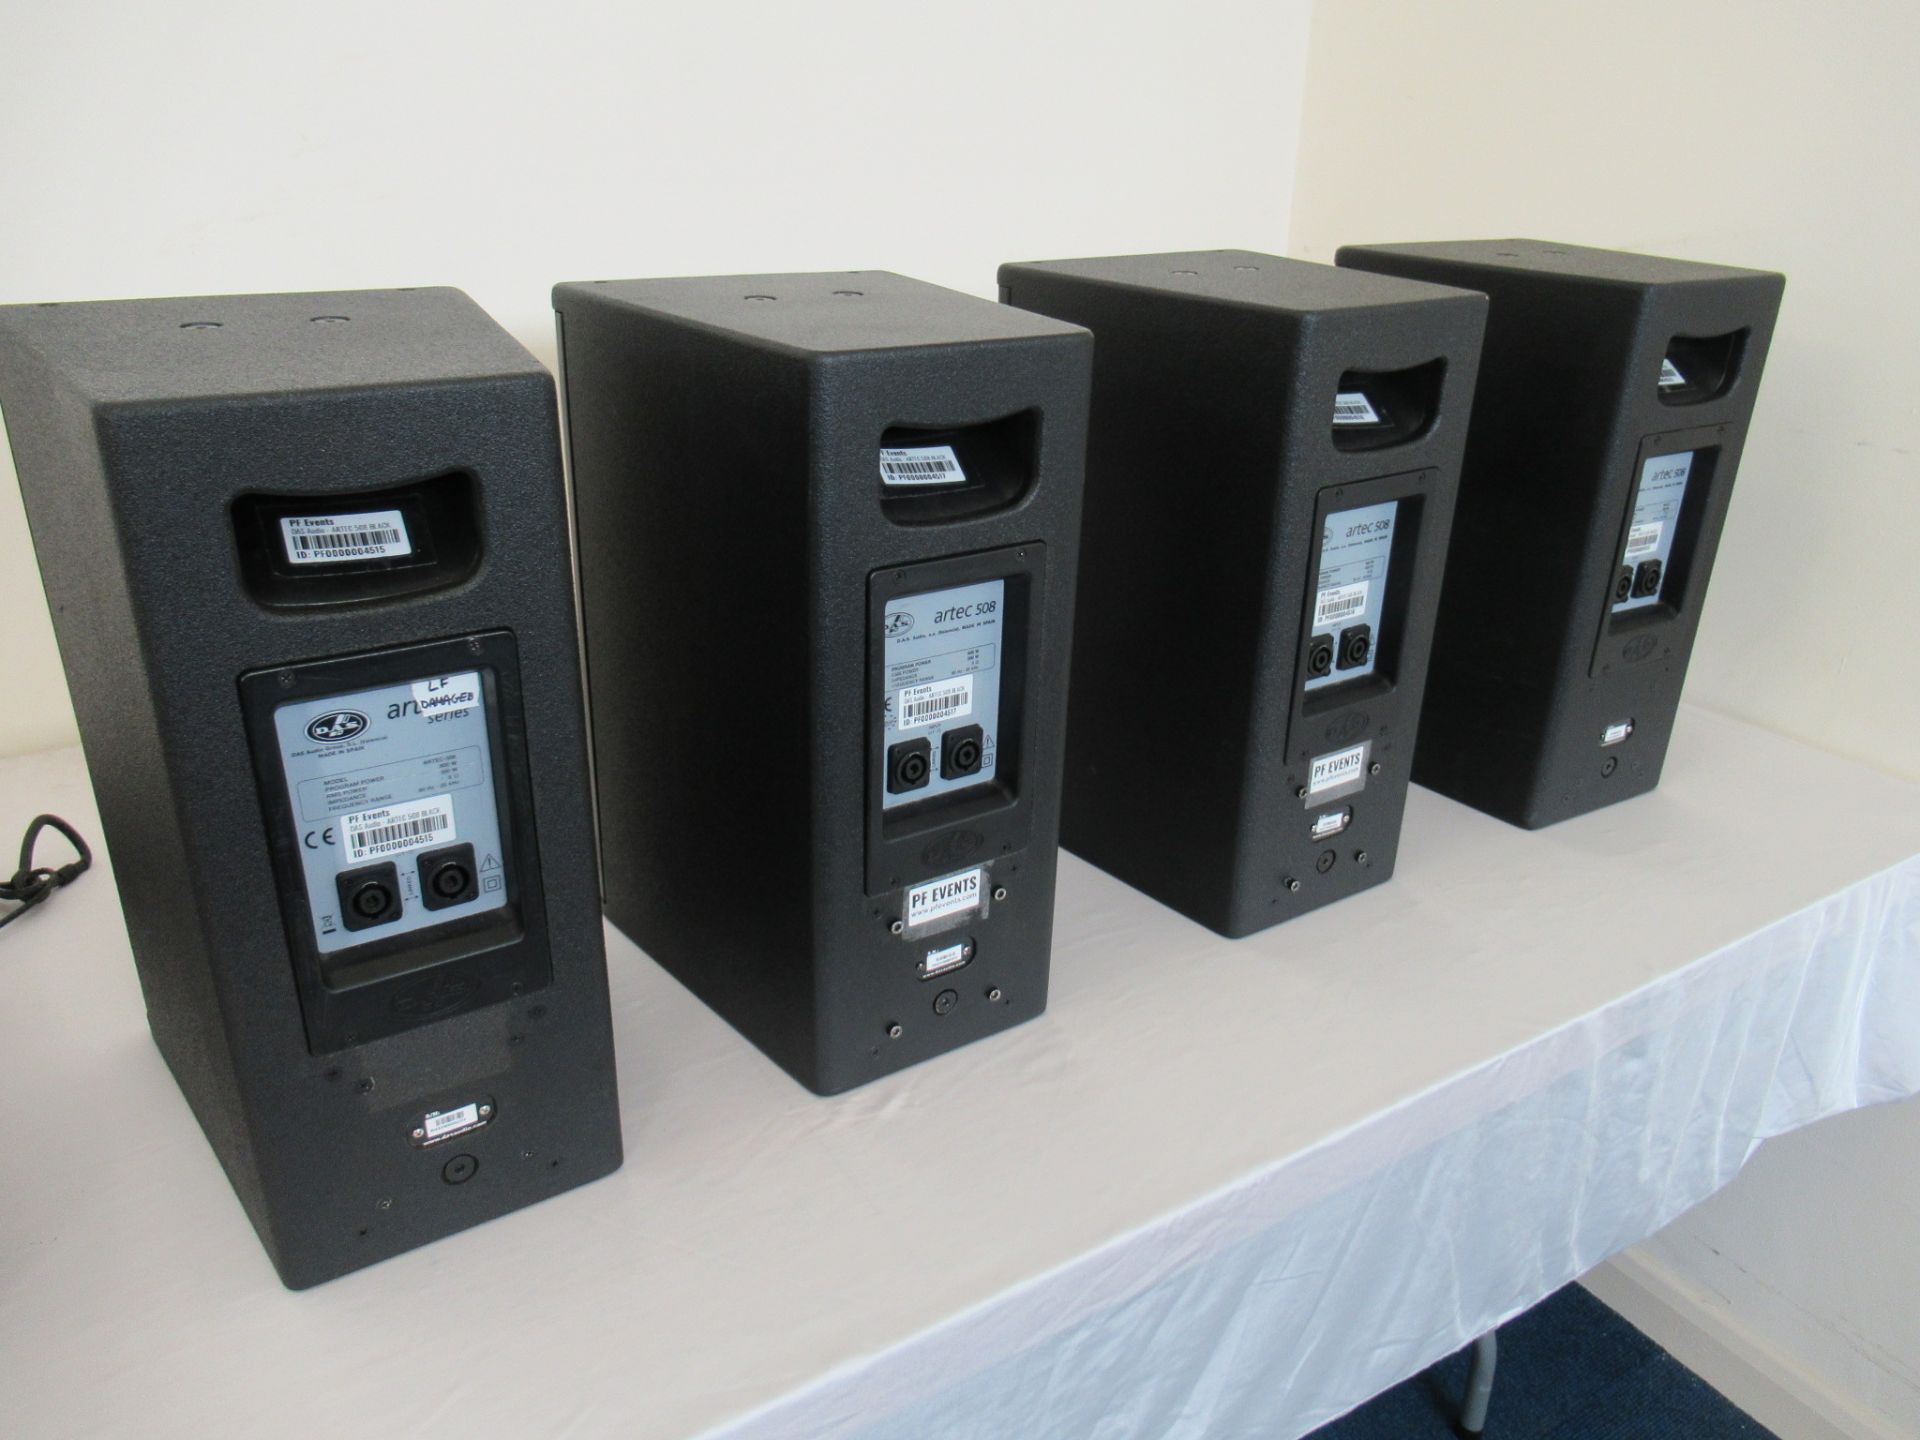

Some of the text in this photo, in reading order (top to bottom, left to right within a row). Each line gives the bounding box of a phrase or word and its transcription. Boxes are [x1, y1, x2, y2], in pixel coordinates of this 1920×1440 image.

[289, 518, 335, 527] PF Events
[1346, 522, 1373, 538] artec
[296, 545, 386, 559] ID: PF0000004515
[934, 600, 997, 624] artec 508
[913, 686, 932, 696] Events
[427, 708, 470, 725] series
[315, 713, 360, 738] DAS
[1314, 753, 1361, 778] PF EVENTS
[349, 808, 390, 824] PF Events
[353, 834, 434, 858] ID: PF0000004515
[912, 875, 977, 909] PF EVENTS
